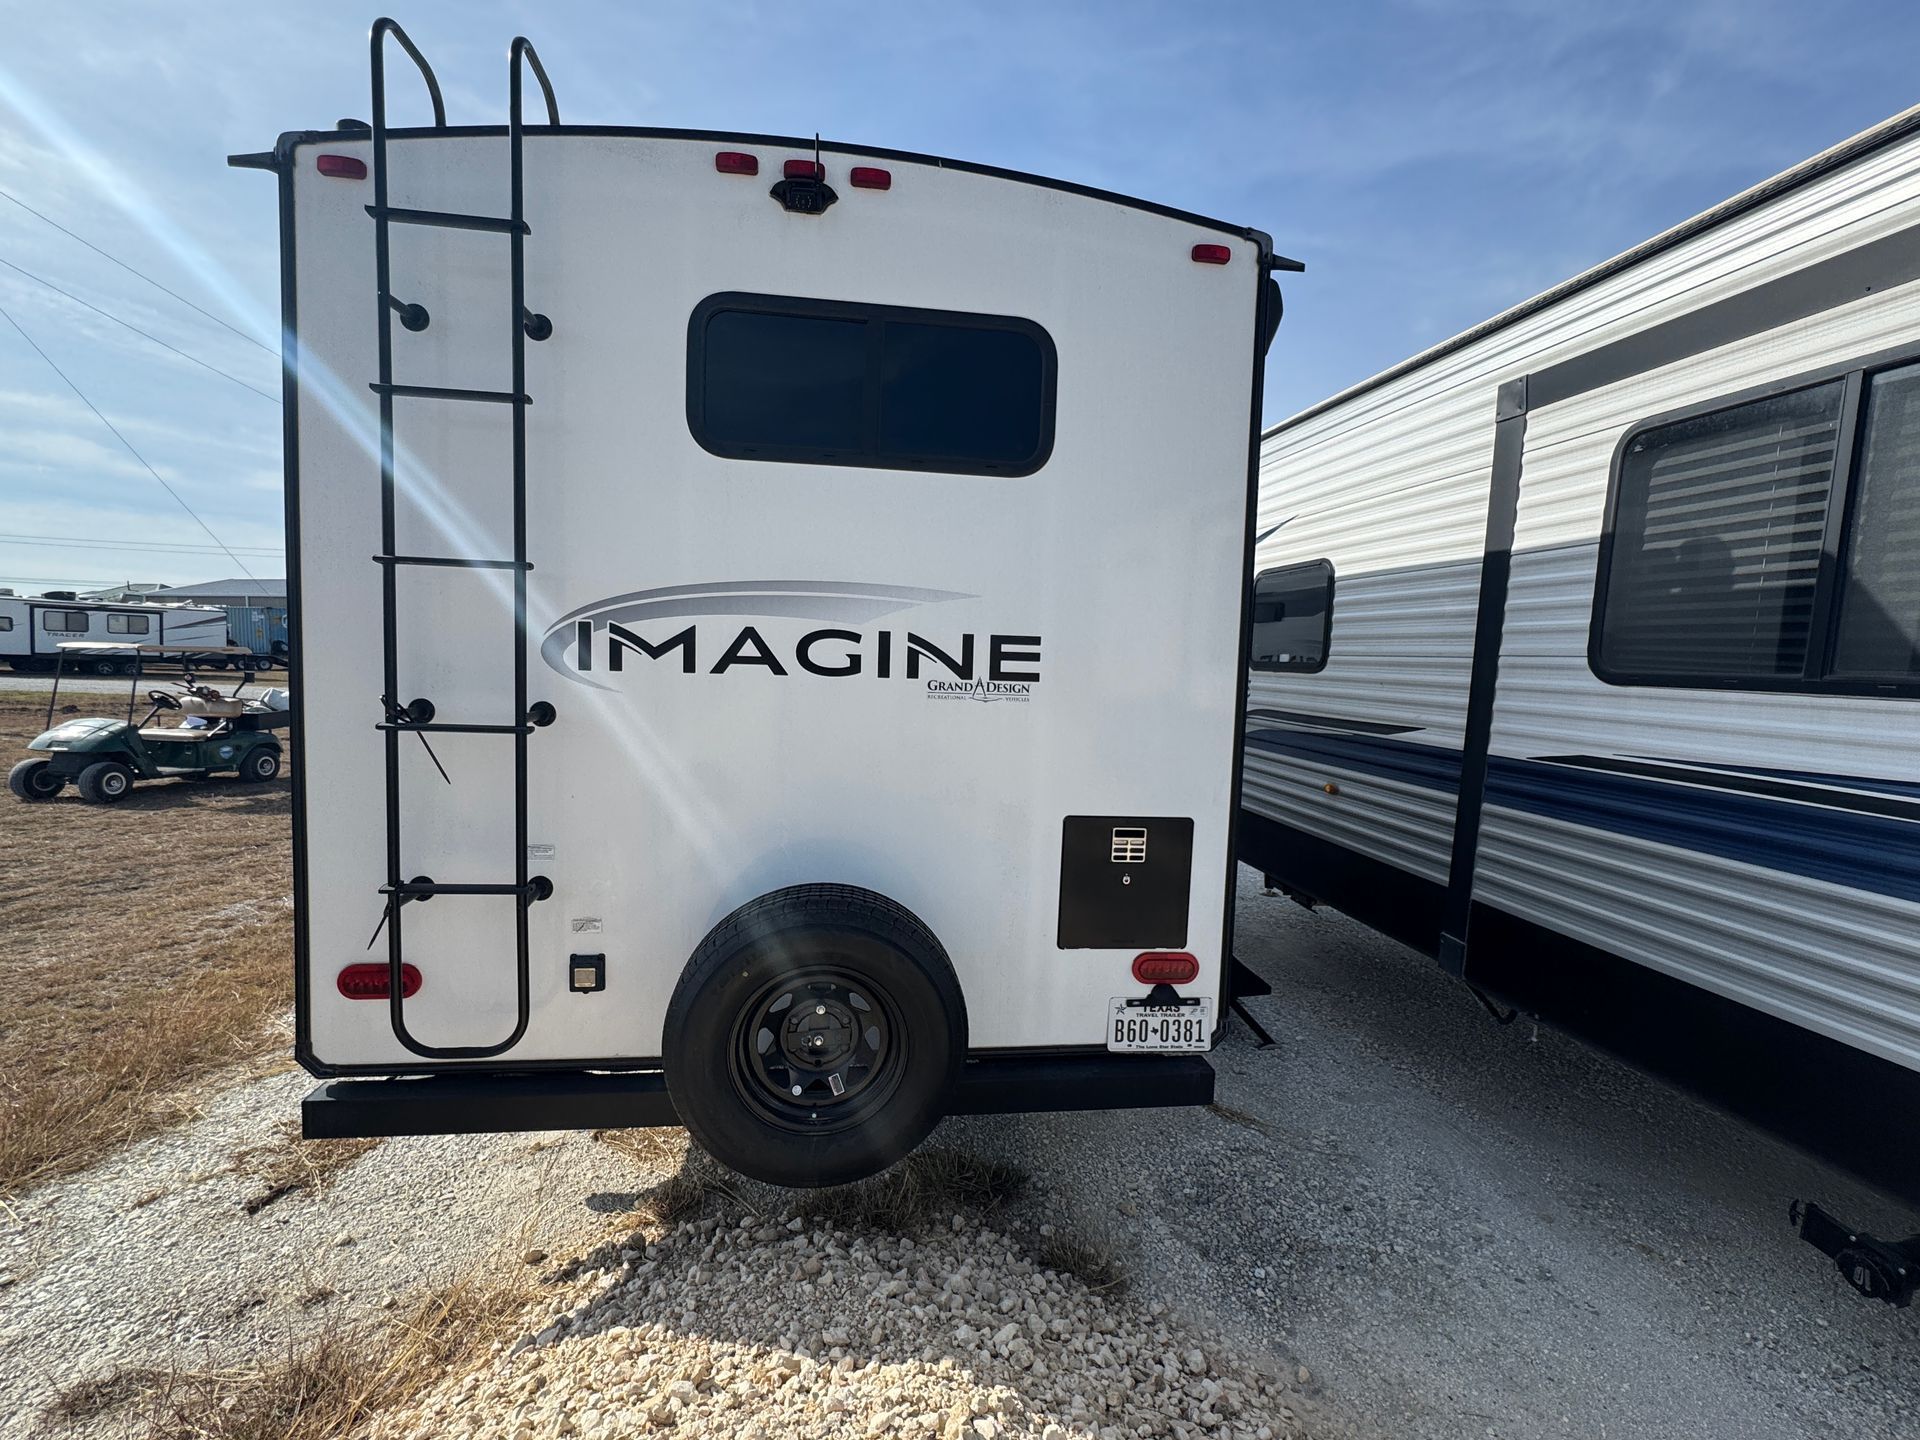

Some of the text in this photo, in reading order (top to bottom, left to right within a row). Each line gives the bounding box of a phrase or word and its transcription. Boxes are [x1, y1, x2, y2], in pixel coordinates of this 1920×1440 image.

[578, 621, 1041, 682] IMAGINE
[927, 680, 1030, 693] GRAND DESIGN
